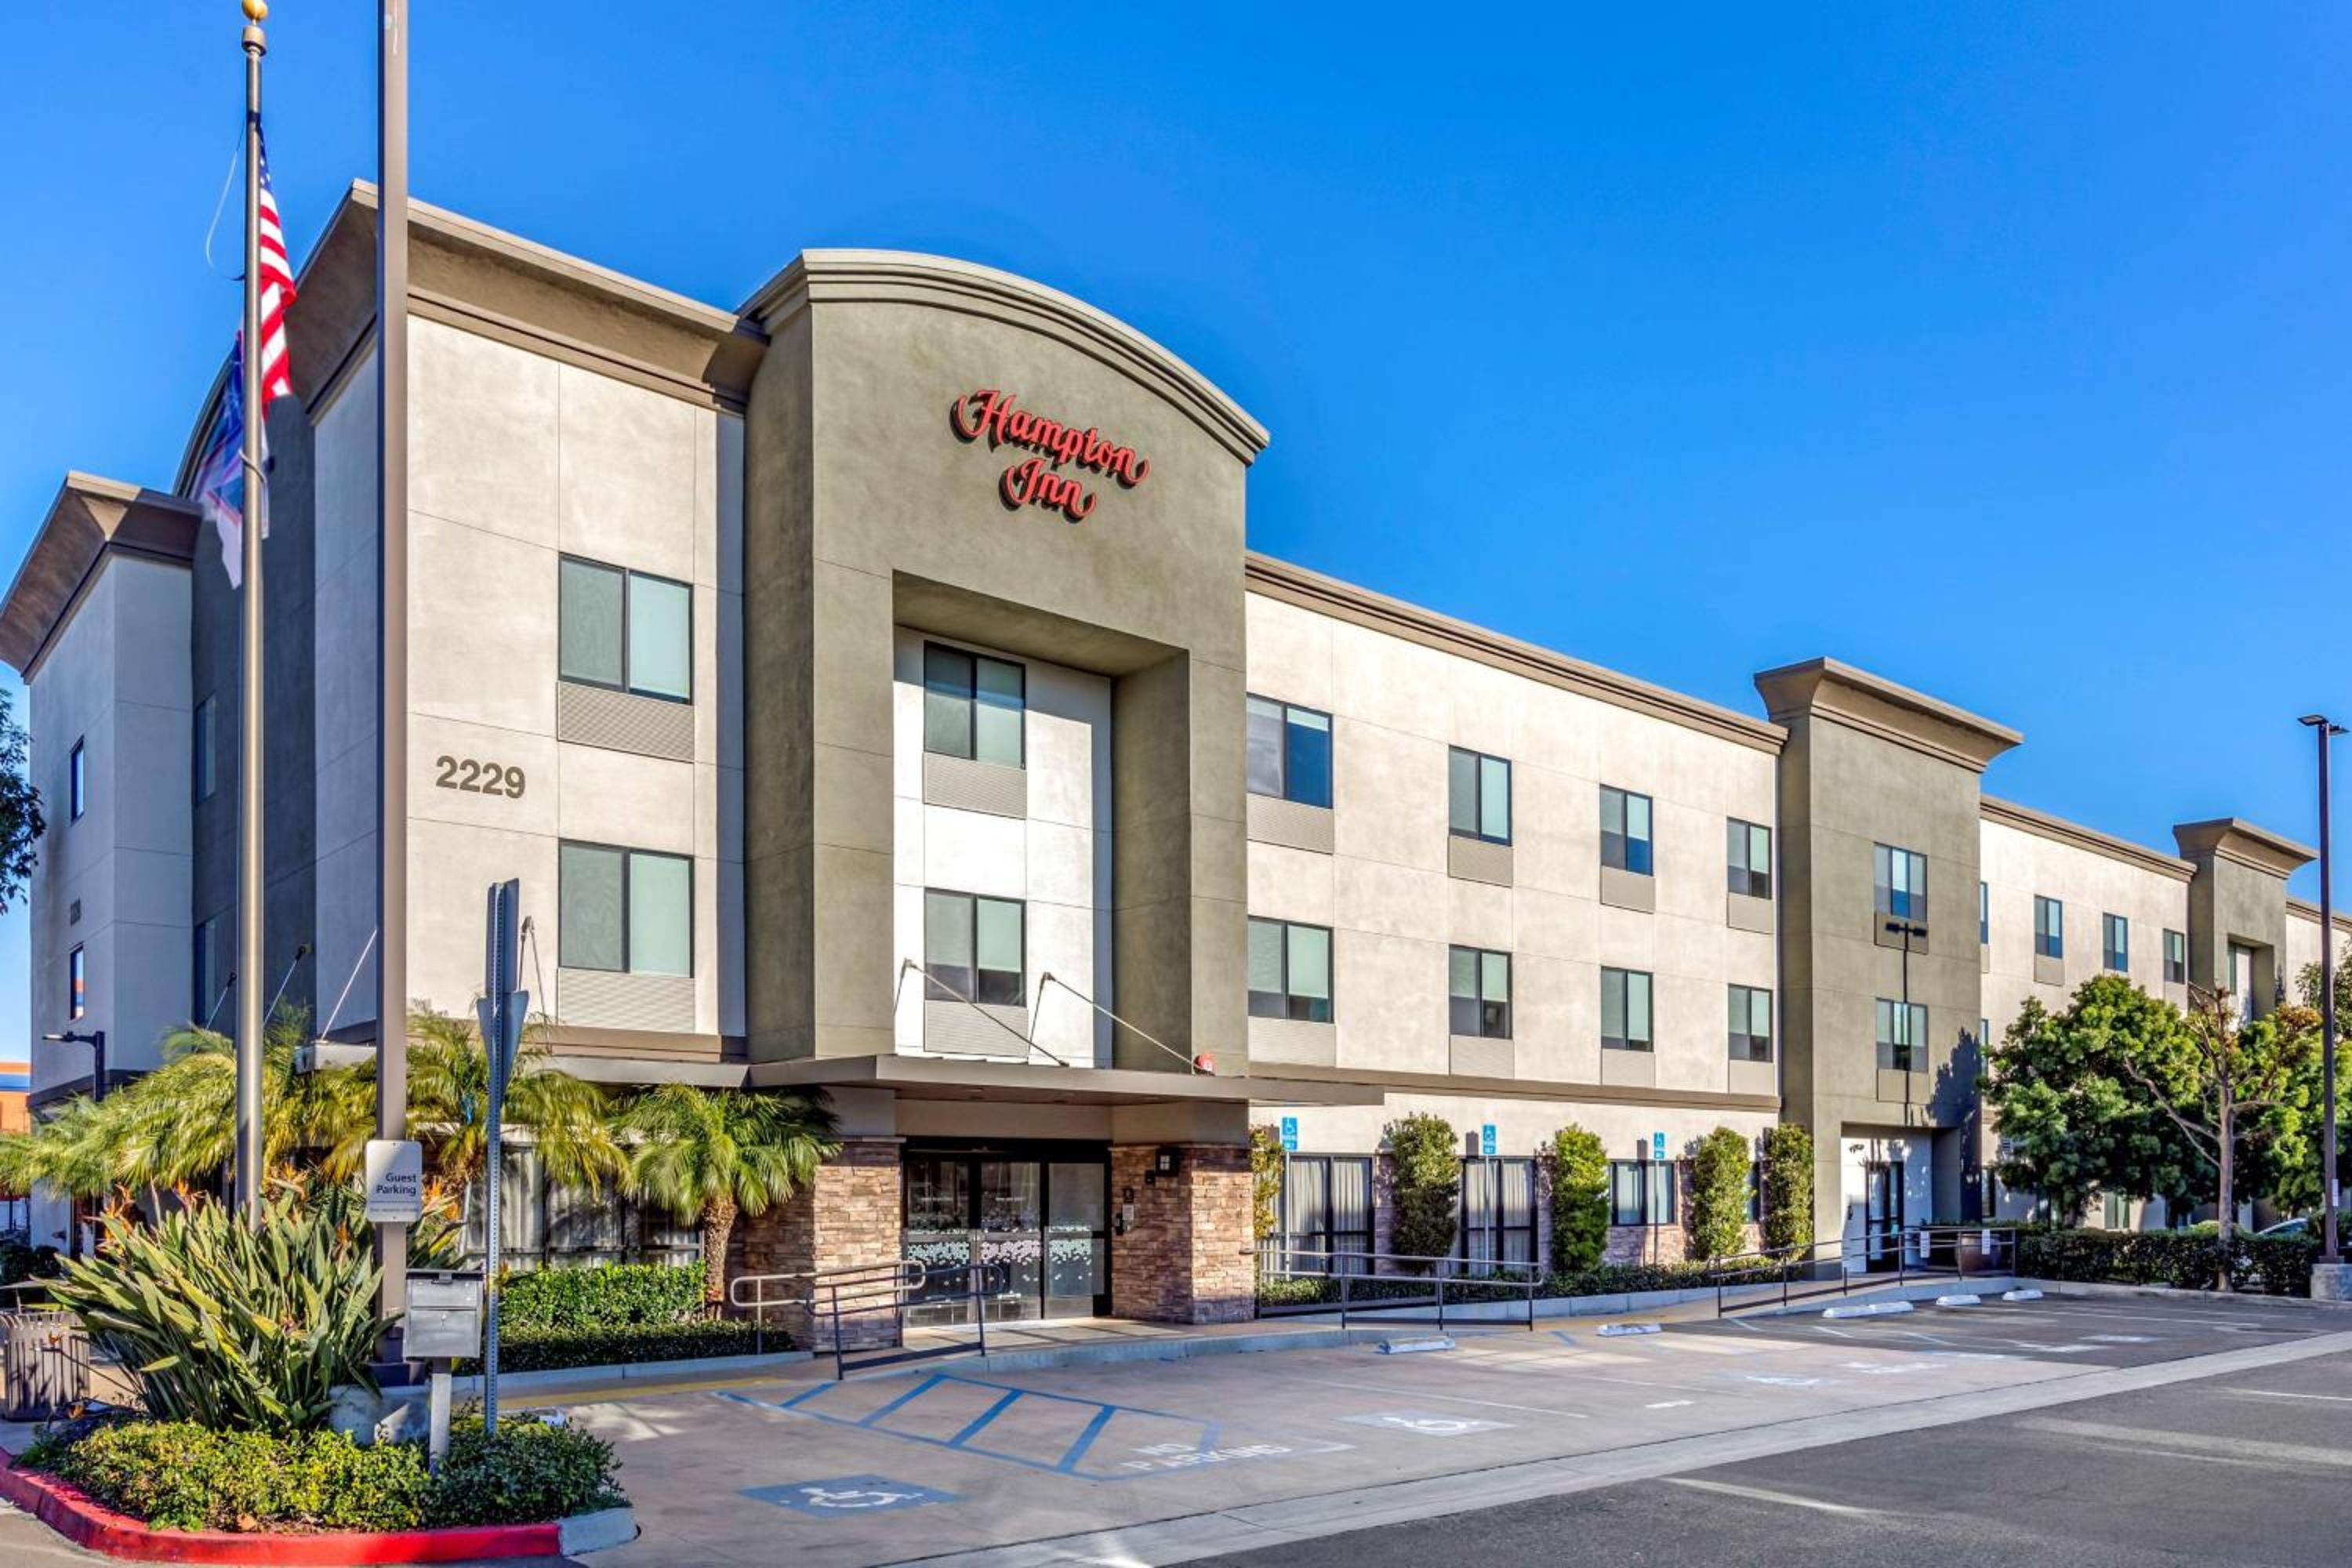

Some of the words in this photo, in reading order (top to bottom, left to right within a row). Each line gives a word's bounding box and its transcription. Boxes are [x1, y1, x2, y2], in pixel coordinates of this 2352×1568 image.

[950, 389, 1150, 487] Hampton
[1000, 457, 1097, 522] Inn
[436, 755, 525, 798] 2229
[376, 1185, 417, 1197] Parking
[385, 1172, 417, 1183] Guest
